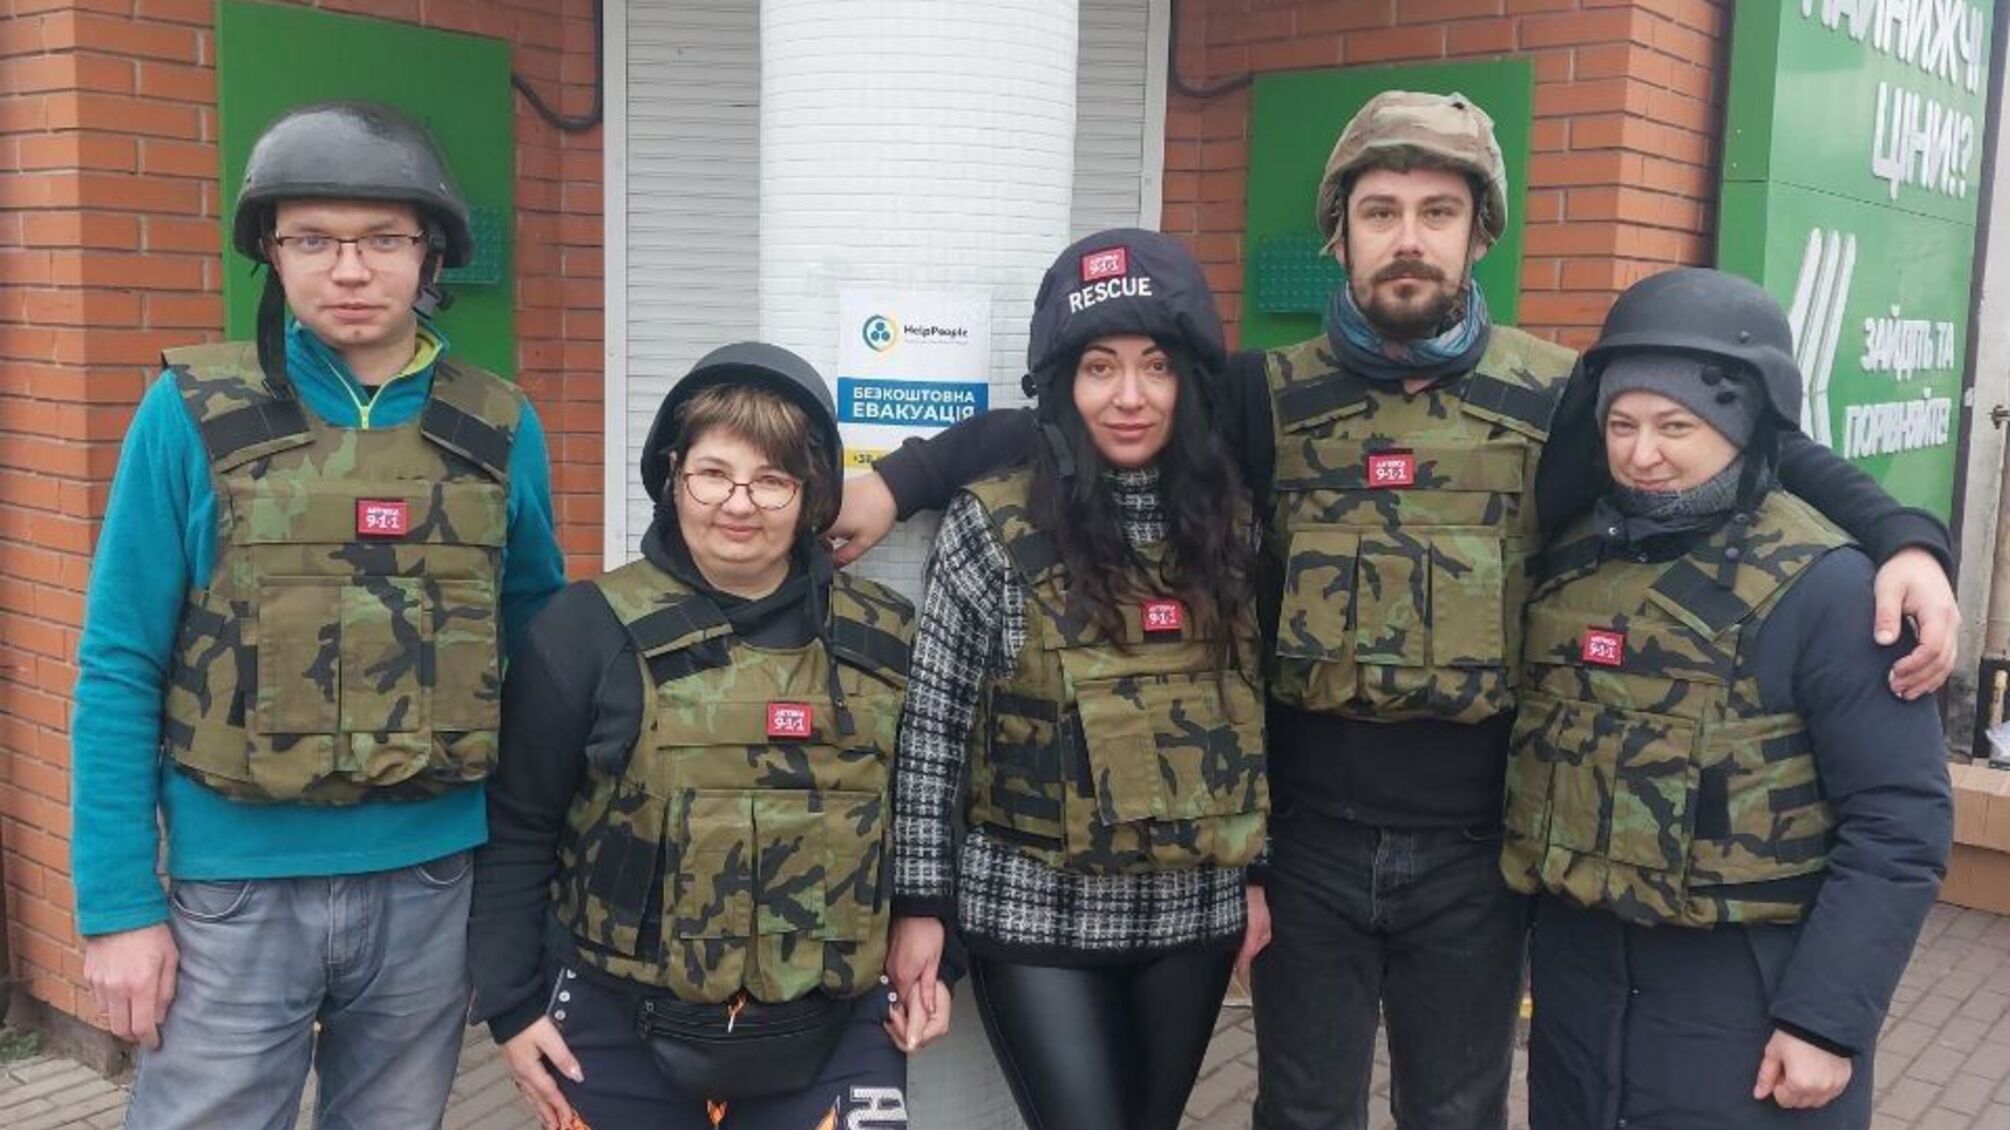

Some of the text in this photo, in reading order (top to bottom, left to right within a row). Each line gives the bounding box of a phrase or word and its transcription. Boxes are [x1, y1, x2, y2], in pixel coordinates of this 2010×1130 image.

[1803, 0, 1984, 94] НИЖЧІ
[1068, 277, 1152, 313] RESCUE
[853, 386, 976, 403] БЕЗКОШТОВНА
[853, 401, 975, 423] ЕВАКУАЦІЯ
